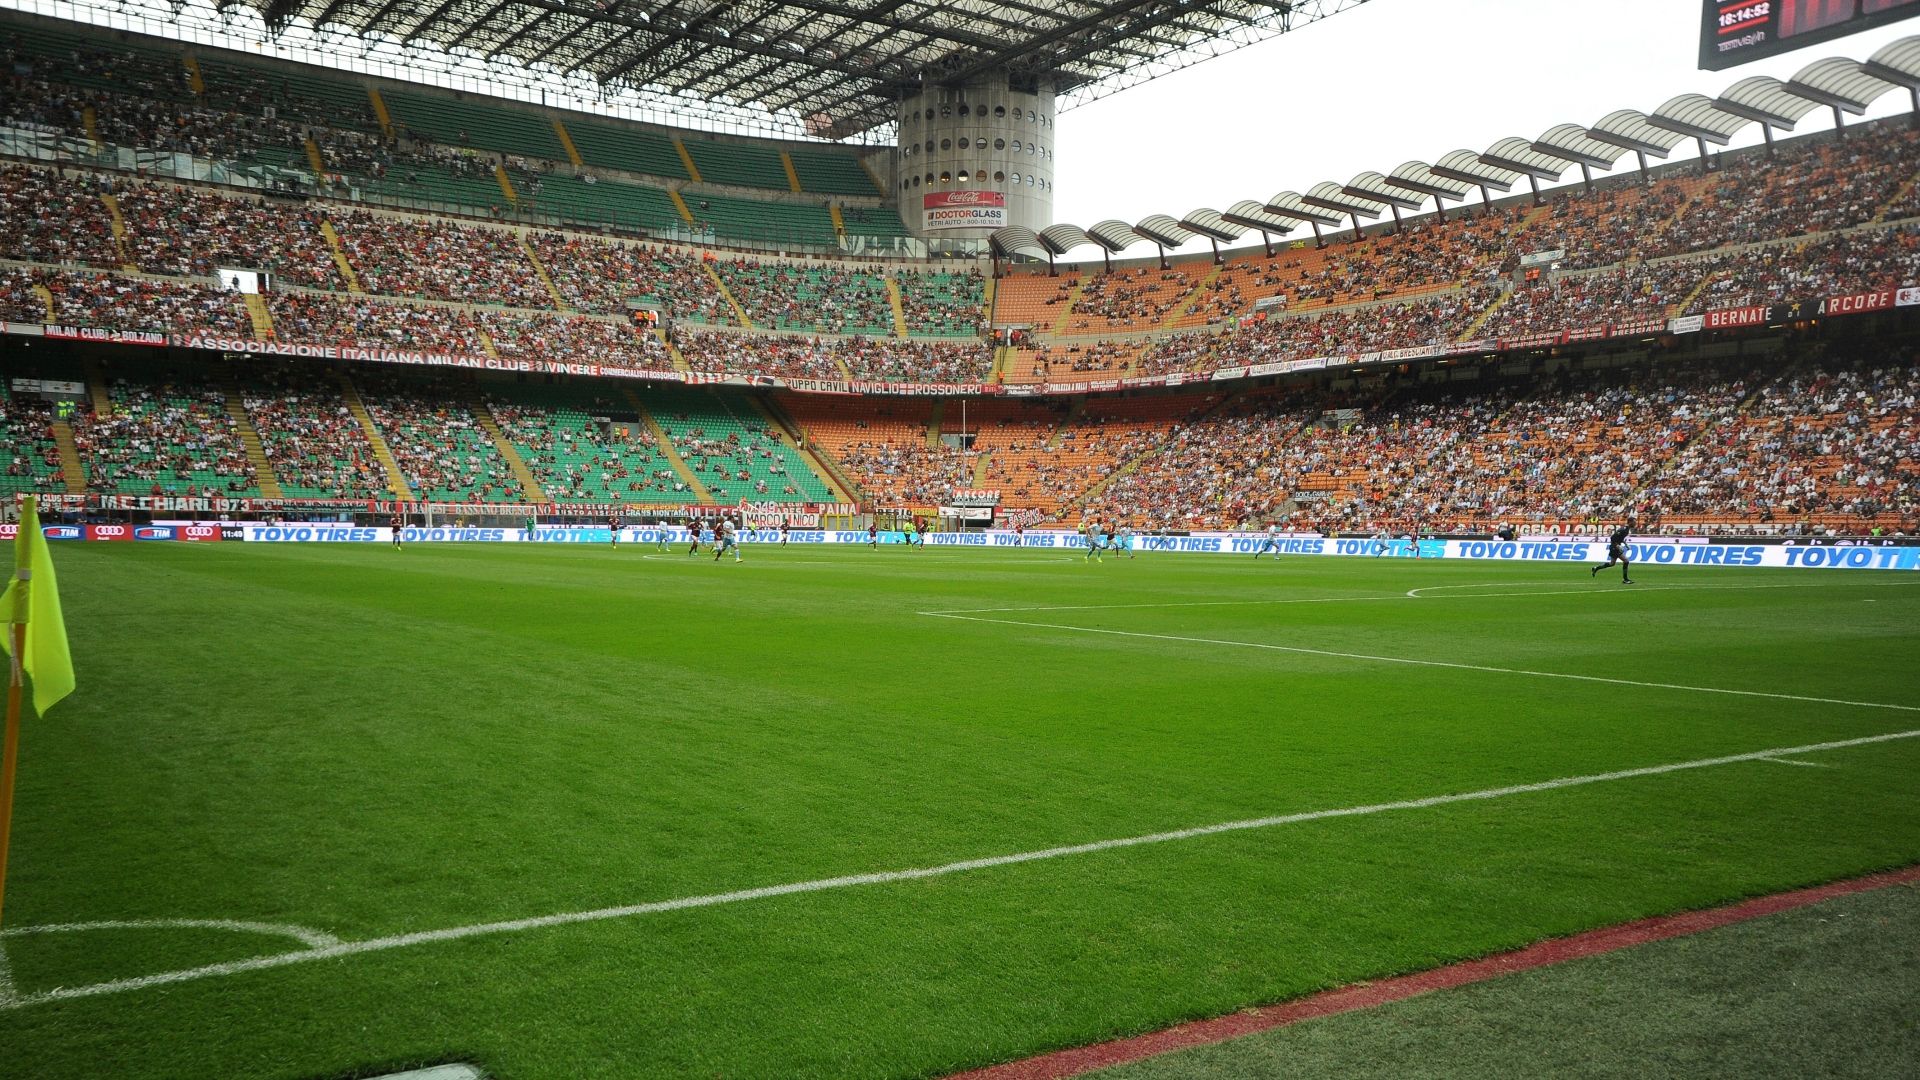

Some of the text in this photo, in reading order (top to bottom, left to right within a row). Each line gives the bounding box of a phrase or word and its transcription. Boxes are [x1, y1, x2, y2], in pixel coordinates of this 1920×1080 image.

[1718, 2, 1770, 26] 18:14:52
[936, 210, 1001, 219] DOCTORGLASS
[1818, 292, 1889, 315] ARCORE
[1711, 306, 1772, 326] BERNATE
[1611, 324, 1665, 337] BRESCIANO
[1617, 319, 1663, 330] BASSANO
[46, 324, 163, 344] MILAN CLUB BOLZANO
[190, 337, 530, 371] ASSOCIAZIONE ITALIANA MILAN CLUB
[548, 362, 597, 376] VINCERE
[851, 382, 899, 394] NAVIGLIO
[915, 384, 982, 395] ROSSONERO
[215, 498, 250, 512] 1973
[456, 503, 498, 515] BASSANO
[819, 503, 857, 516] PAINA
[652, 509, 689, 517] MONTANA
[746, 513, 781, 527] MARCO
[60, 528, 79, 537] TIM
[153, 528, 171, 538] TIM
[252, 528, 377, 541] TOYO TIRES
[450, 528, 505, 542] TIRES
[932, 533, 987, 546] TOYO TIRES
[1023, 535, 1056, 547] TIRES
[1180, 538, 1222, 552] TIRES
[1277, 539, 1325, 554] TIRES
[1459, 541, 1590, 561] TOYO TIRES
[1680, 546, 1765, 565] TIRES
[1785, 547, 1873, 567] TOYO
